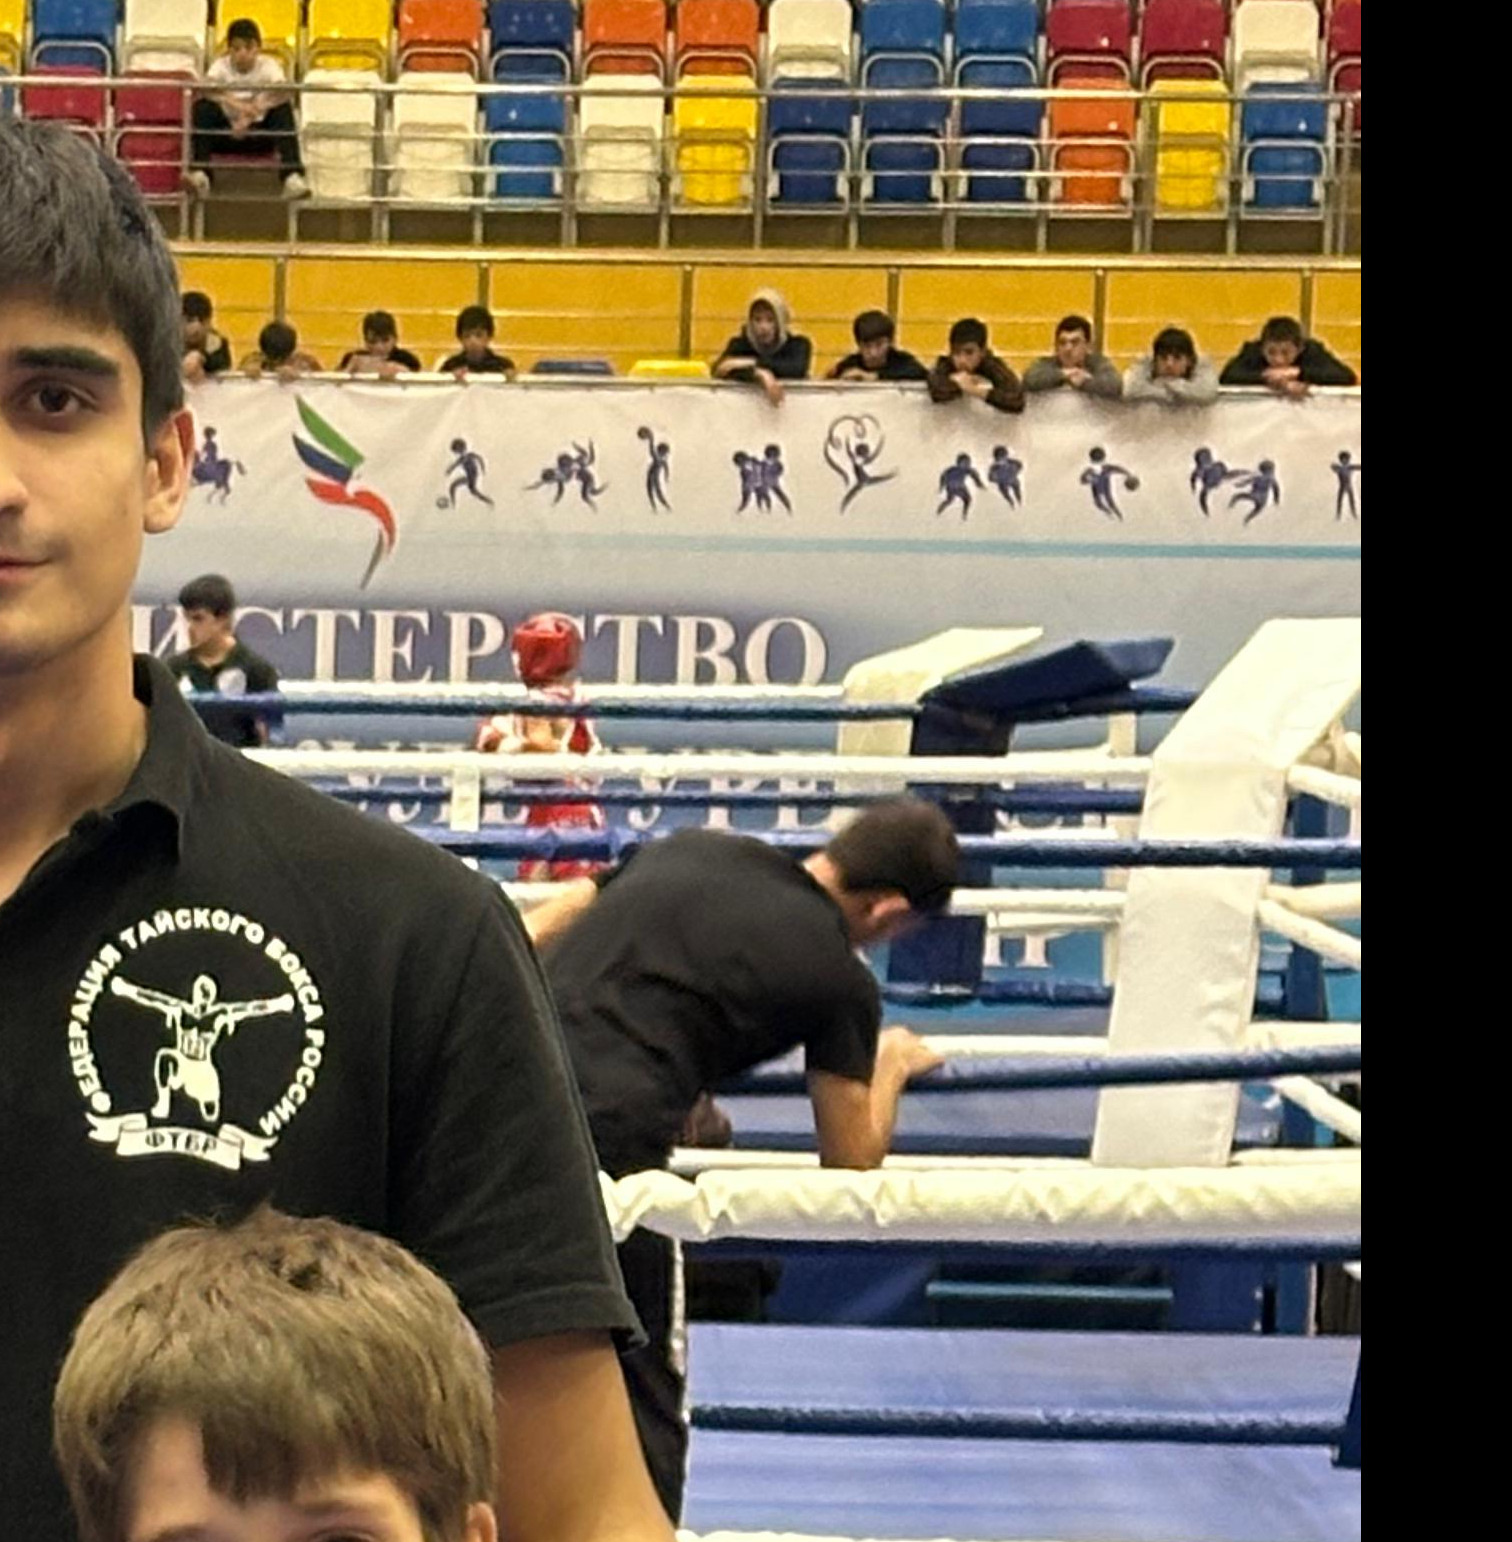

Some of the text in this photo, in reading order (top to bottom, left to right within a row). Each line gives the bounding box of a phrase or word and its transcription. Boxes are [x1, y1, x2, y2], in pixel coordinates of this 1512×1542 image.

[118, 906, 265, 950] ТАЙСКОГО
[264, 936, 324, 1024] БОКСА
[258, 1027, 326, 1137] РОССИИ
[144, 1131, 218, 1155] ФТБР
